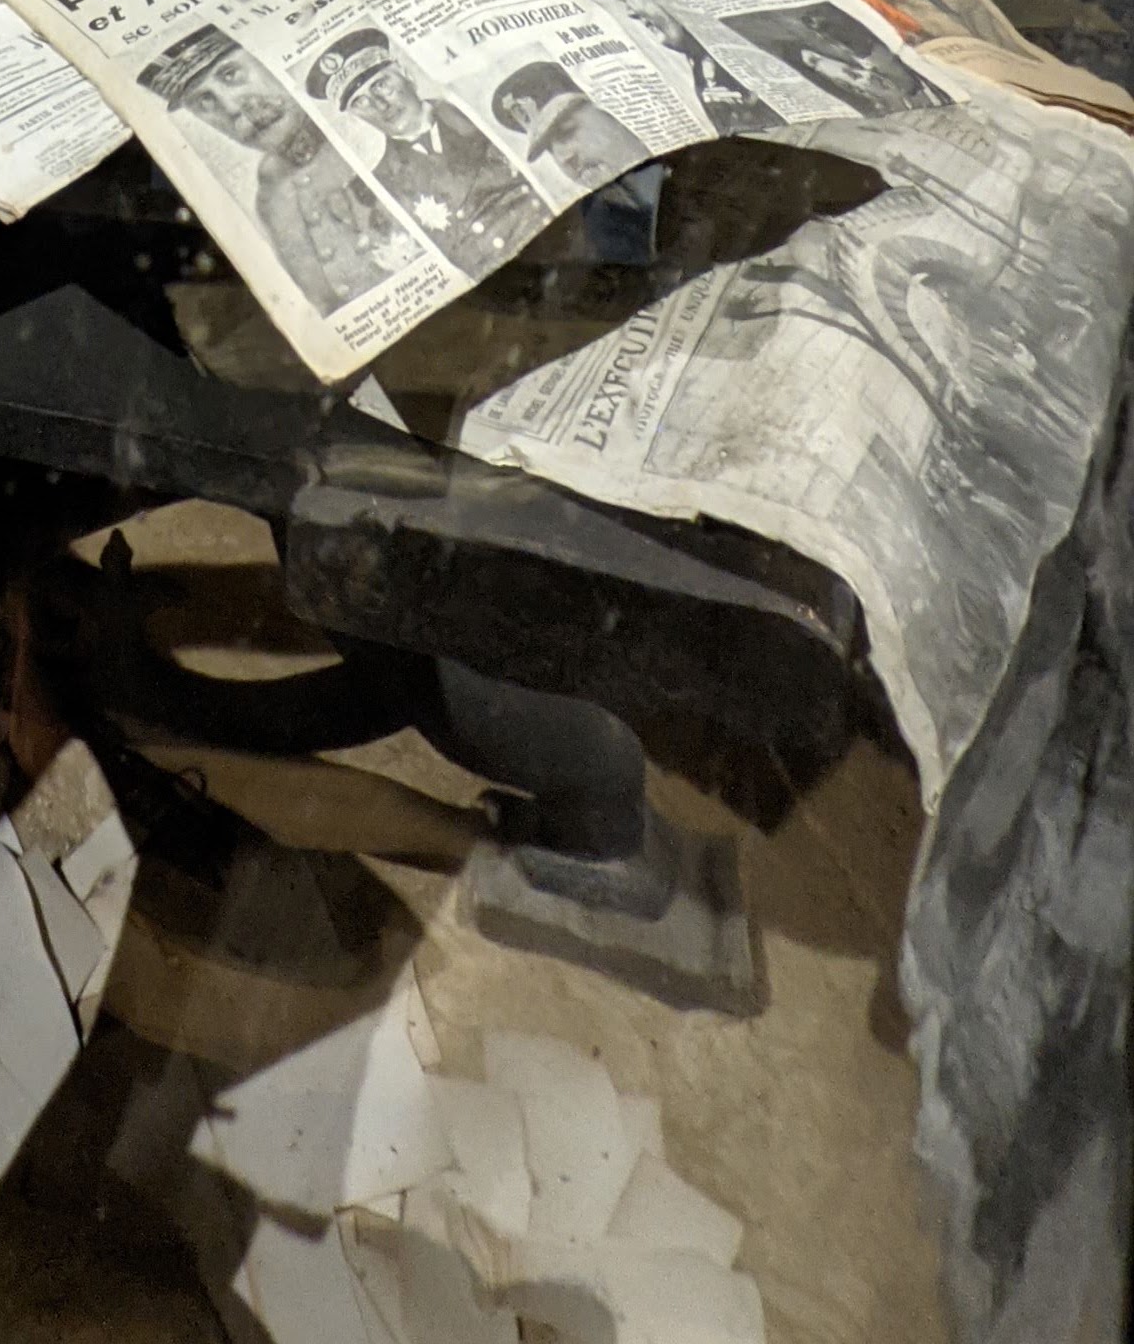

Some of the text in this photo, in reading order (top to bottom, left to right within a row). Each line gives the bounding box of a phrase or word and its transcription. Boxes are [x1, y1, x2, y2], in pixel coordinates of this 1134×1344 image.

[88, 5, 126, 31] et
[466, 1, 585, 46] BORDIGHERA
[122, 25, 152, 44] se
[574, 22, 604, 41] Duce
